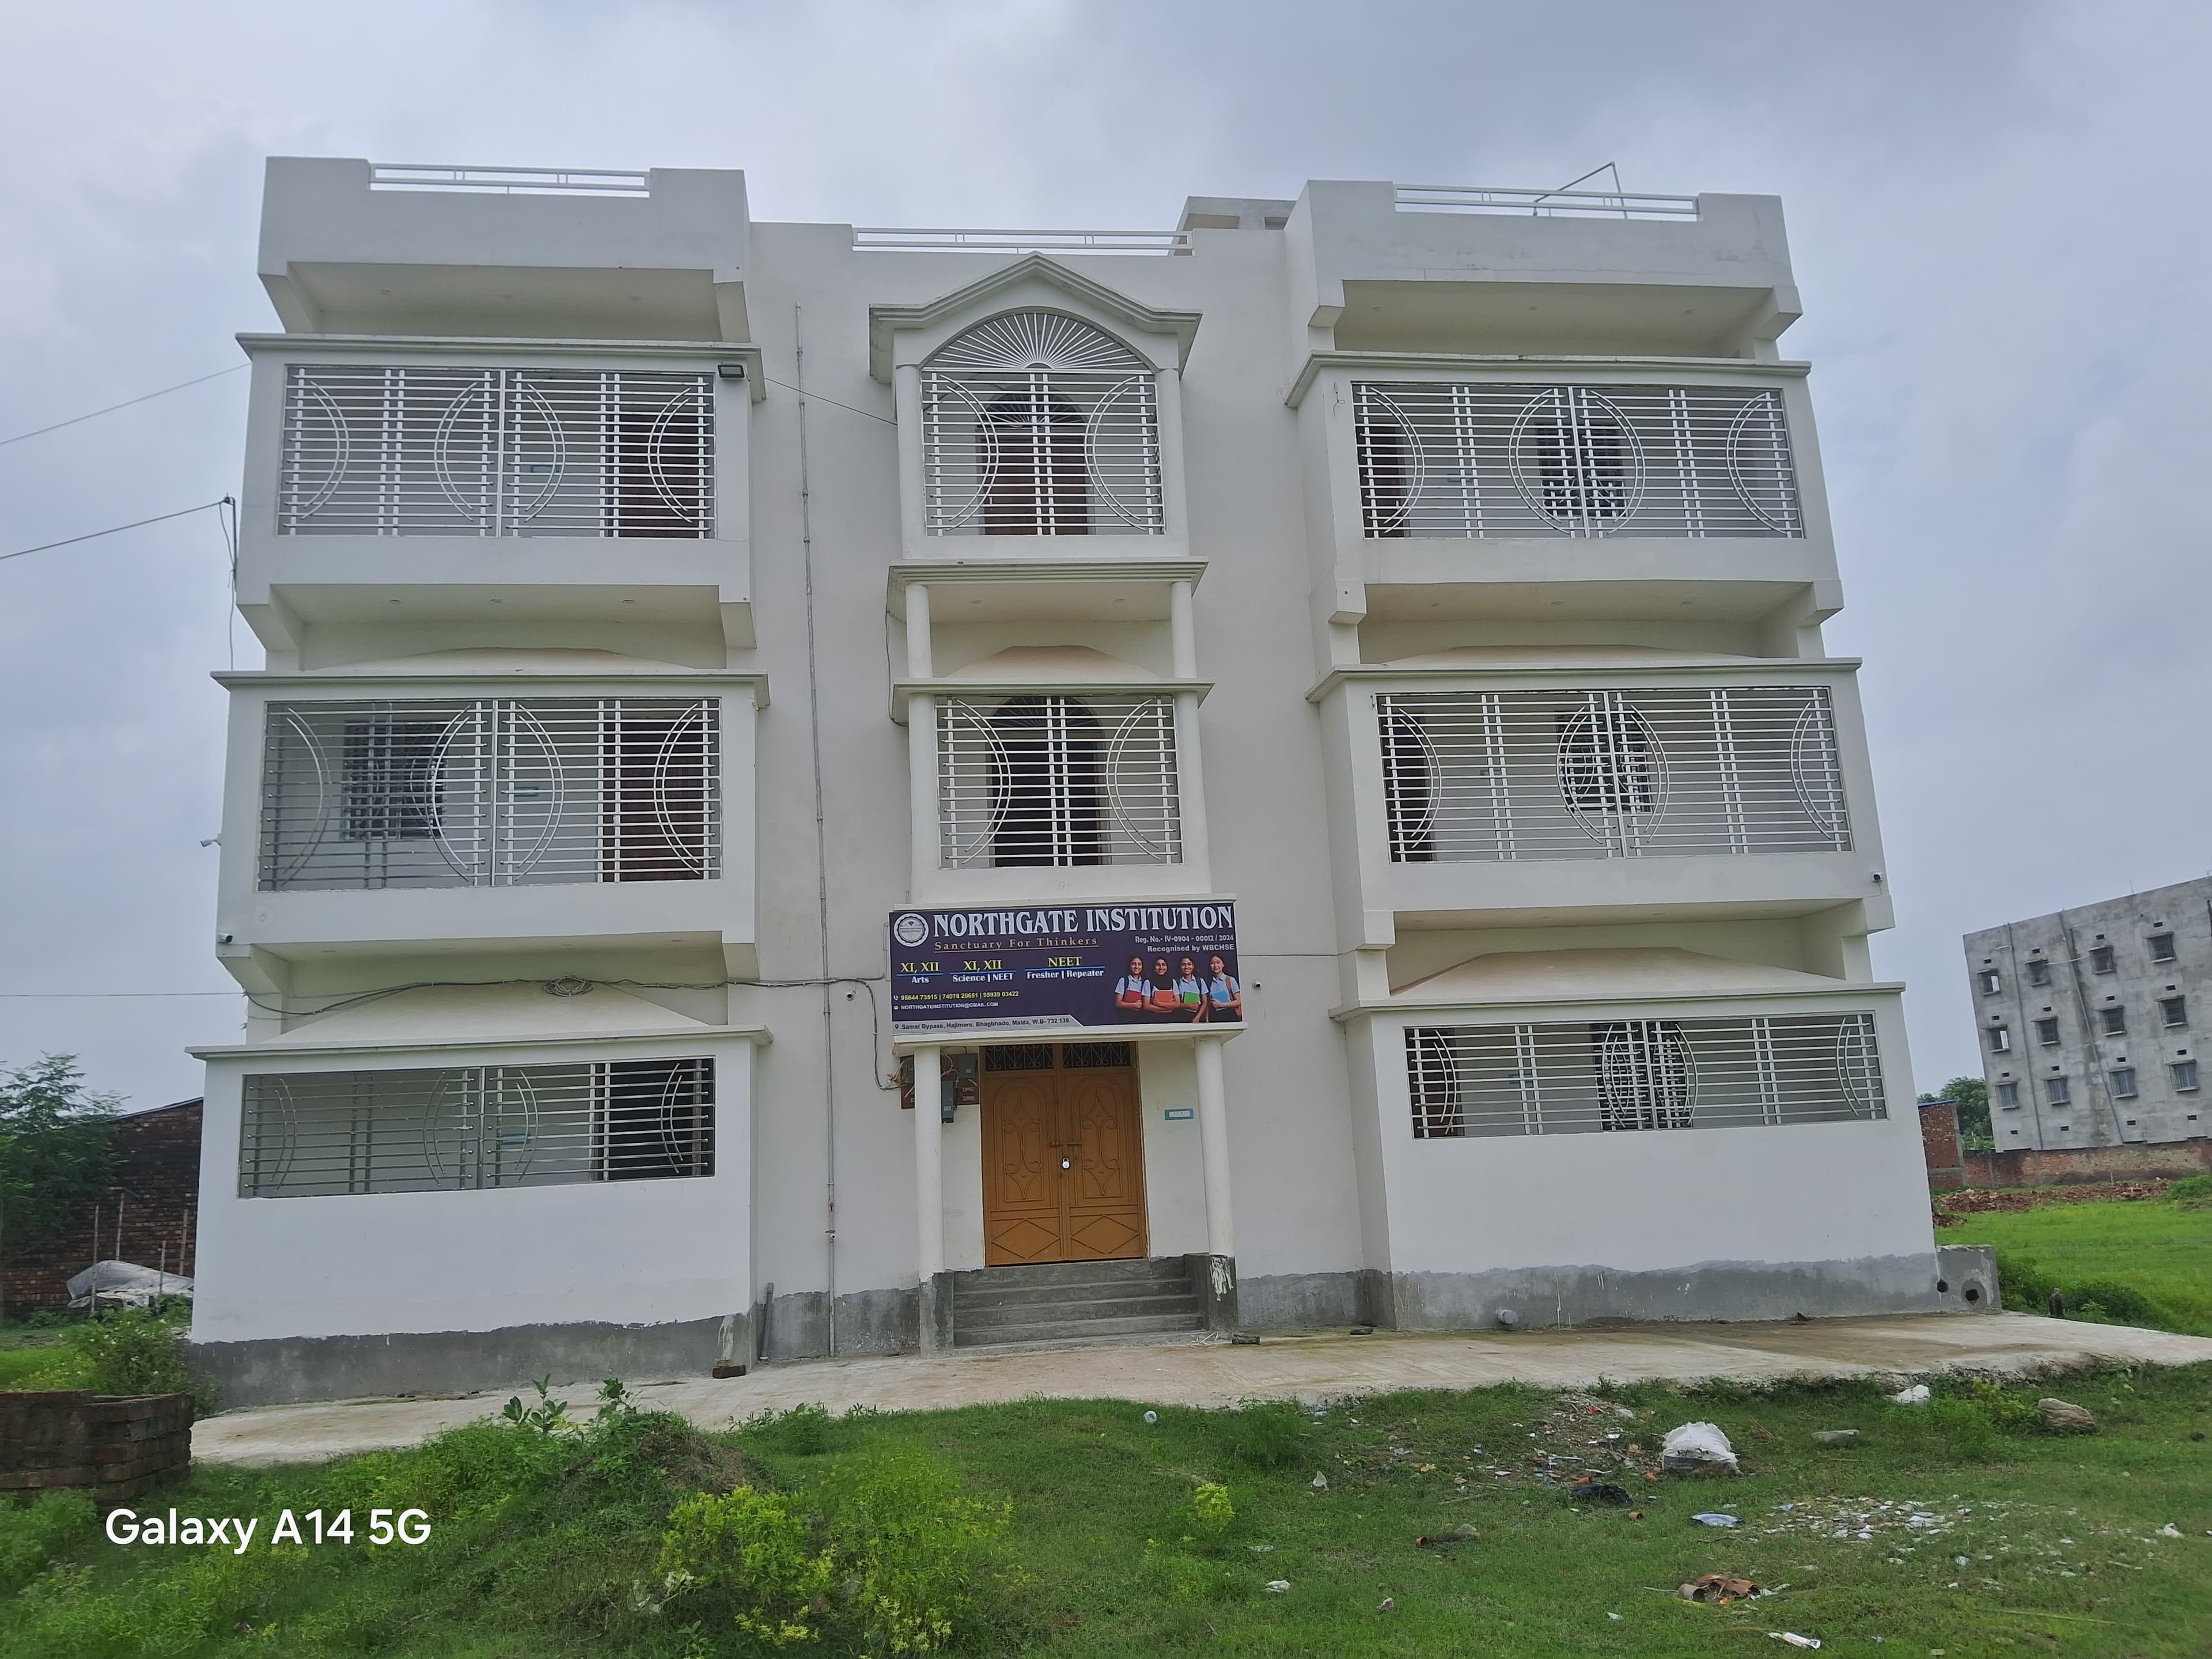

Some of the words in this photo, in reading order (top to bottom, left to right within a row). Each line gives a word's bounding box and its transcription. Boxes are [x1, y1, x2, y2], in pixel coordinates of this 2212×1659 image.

[934, 909, 1078, 937] NORTHGATE
[1086, 906, 1233, 932] INSTITUTION
[934, 941, 1002, 950] Sanctuary
[1009, 939, 1030, 948] For
[1037, 937, 1097, 946] Thinkers
[1147, 945, 1190, 953] Recognised
[921, 962, 940, 972] XII
[983, 960, 1002, 969] XII
[1048, 957, 1082, 967] NEET
[953, 974, 986, 982] Science
[993, 972, 1014, 980] NEET
[1067, 969, 1104, 978] Repeater
